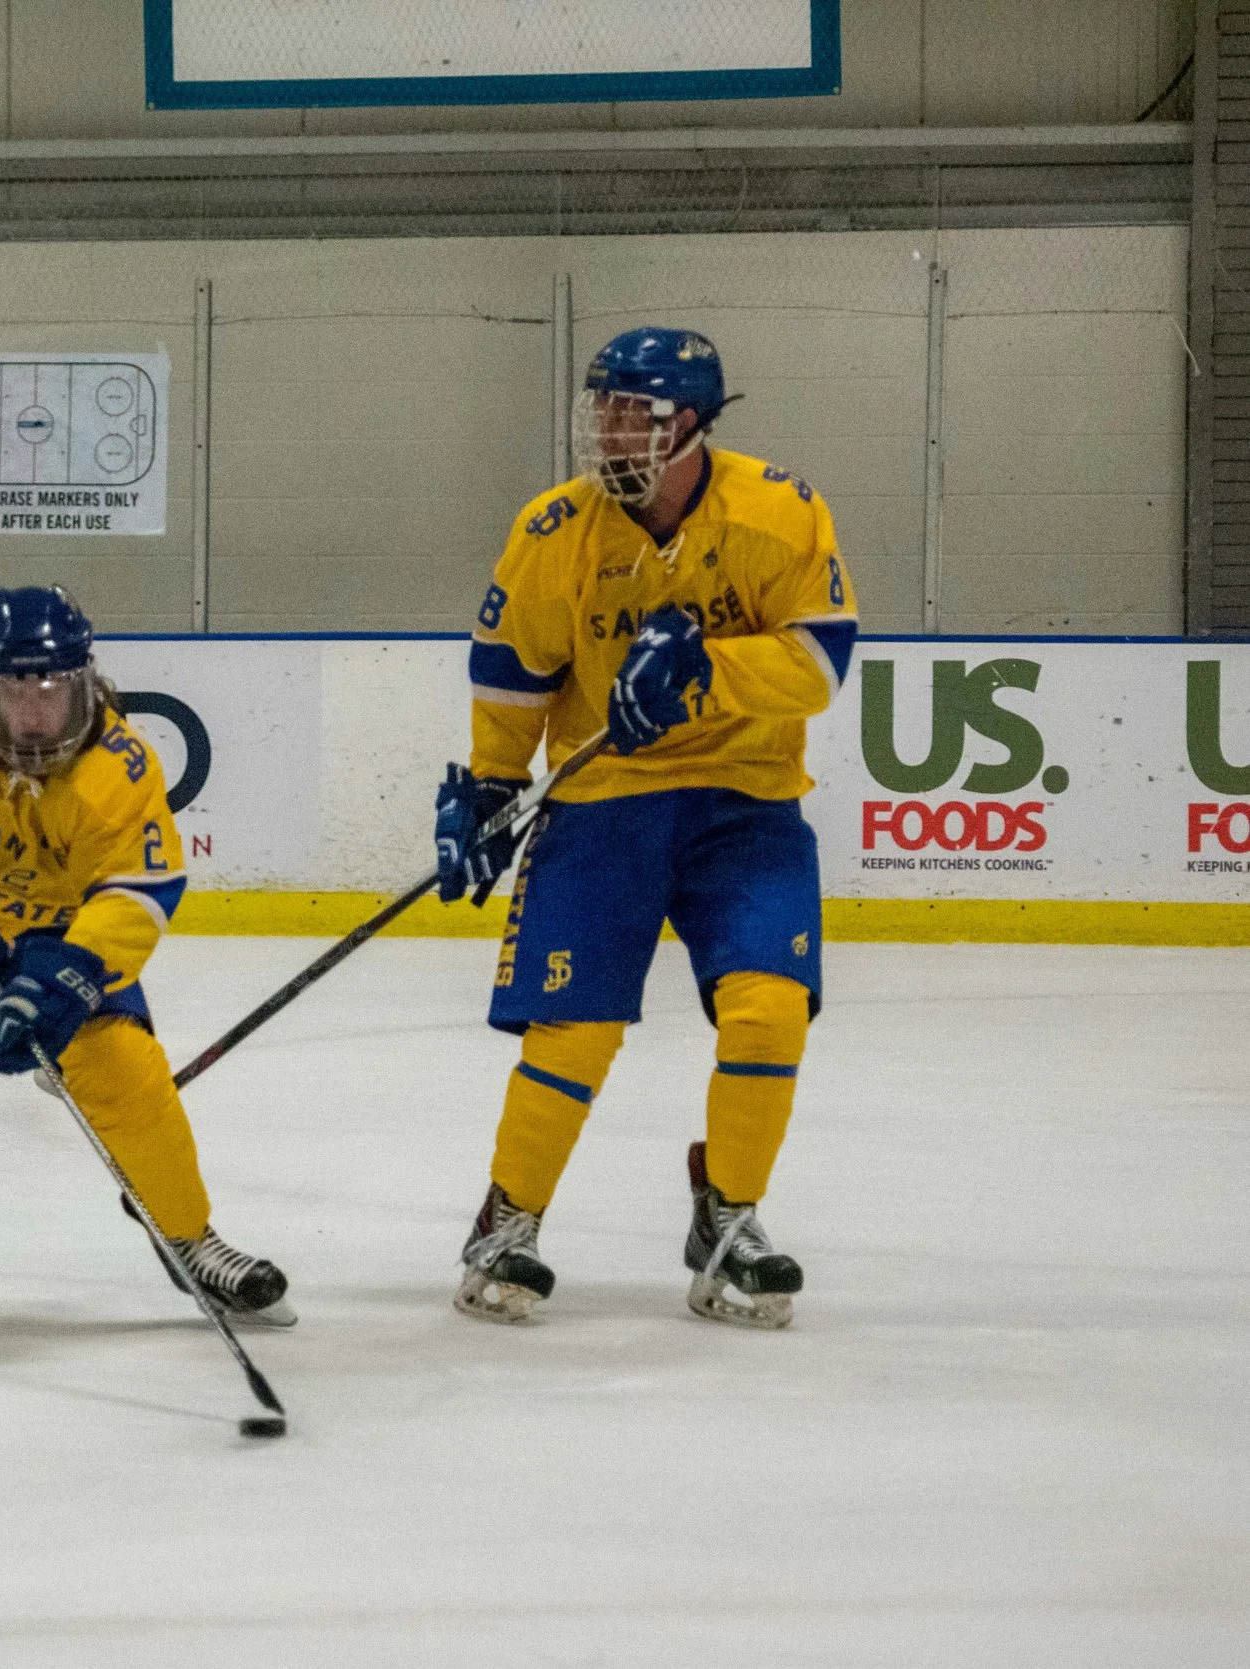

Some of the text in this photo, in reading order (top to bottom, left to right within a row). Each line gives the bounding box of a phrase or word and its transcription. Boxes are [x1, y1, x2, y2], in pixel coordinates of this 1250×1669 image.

[38, 491, 100, 507] MARKERS
[104, 491, 140, 507] ONLY
[0, 514, 42, 529] AFTER
[46, 514, 81, 530] EACH
[85, 514, 111, 530] USE
[828, 555, 845, 607] 8
[477, 582, 508, 630] 8
[862, 800, 1048, 852] FOODS
[143, 820, 169, 871] 2
[861, 857, 916, 870] KEEPING
[919, 858, 981, 871] KITCHENS
[1187, 860, 1243, 873] KEEPING
